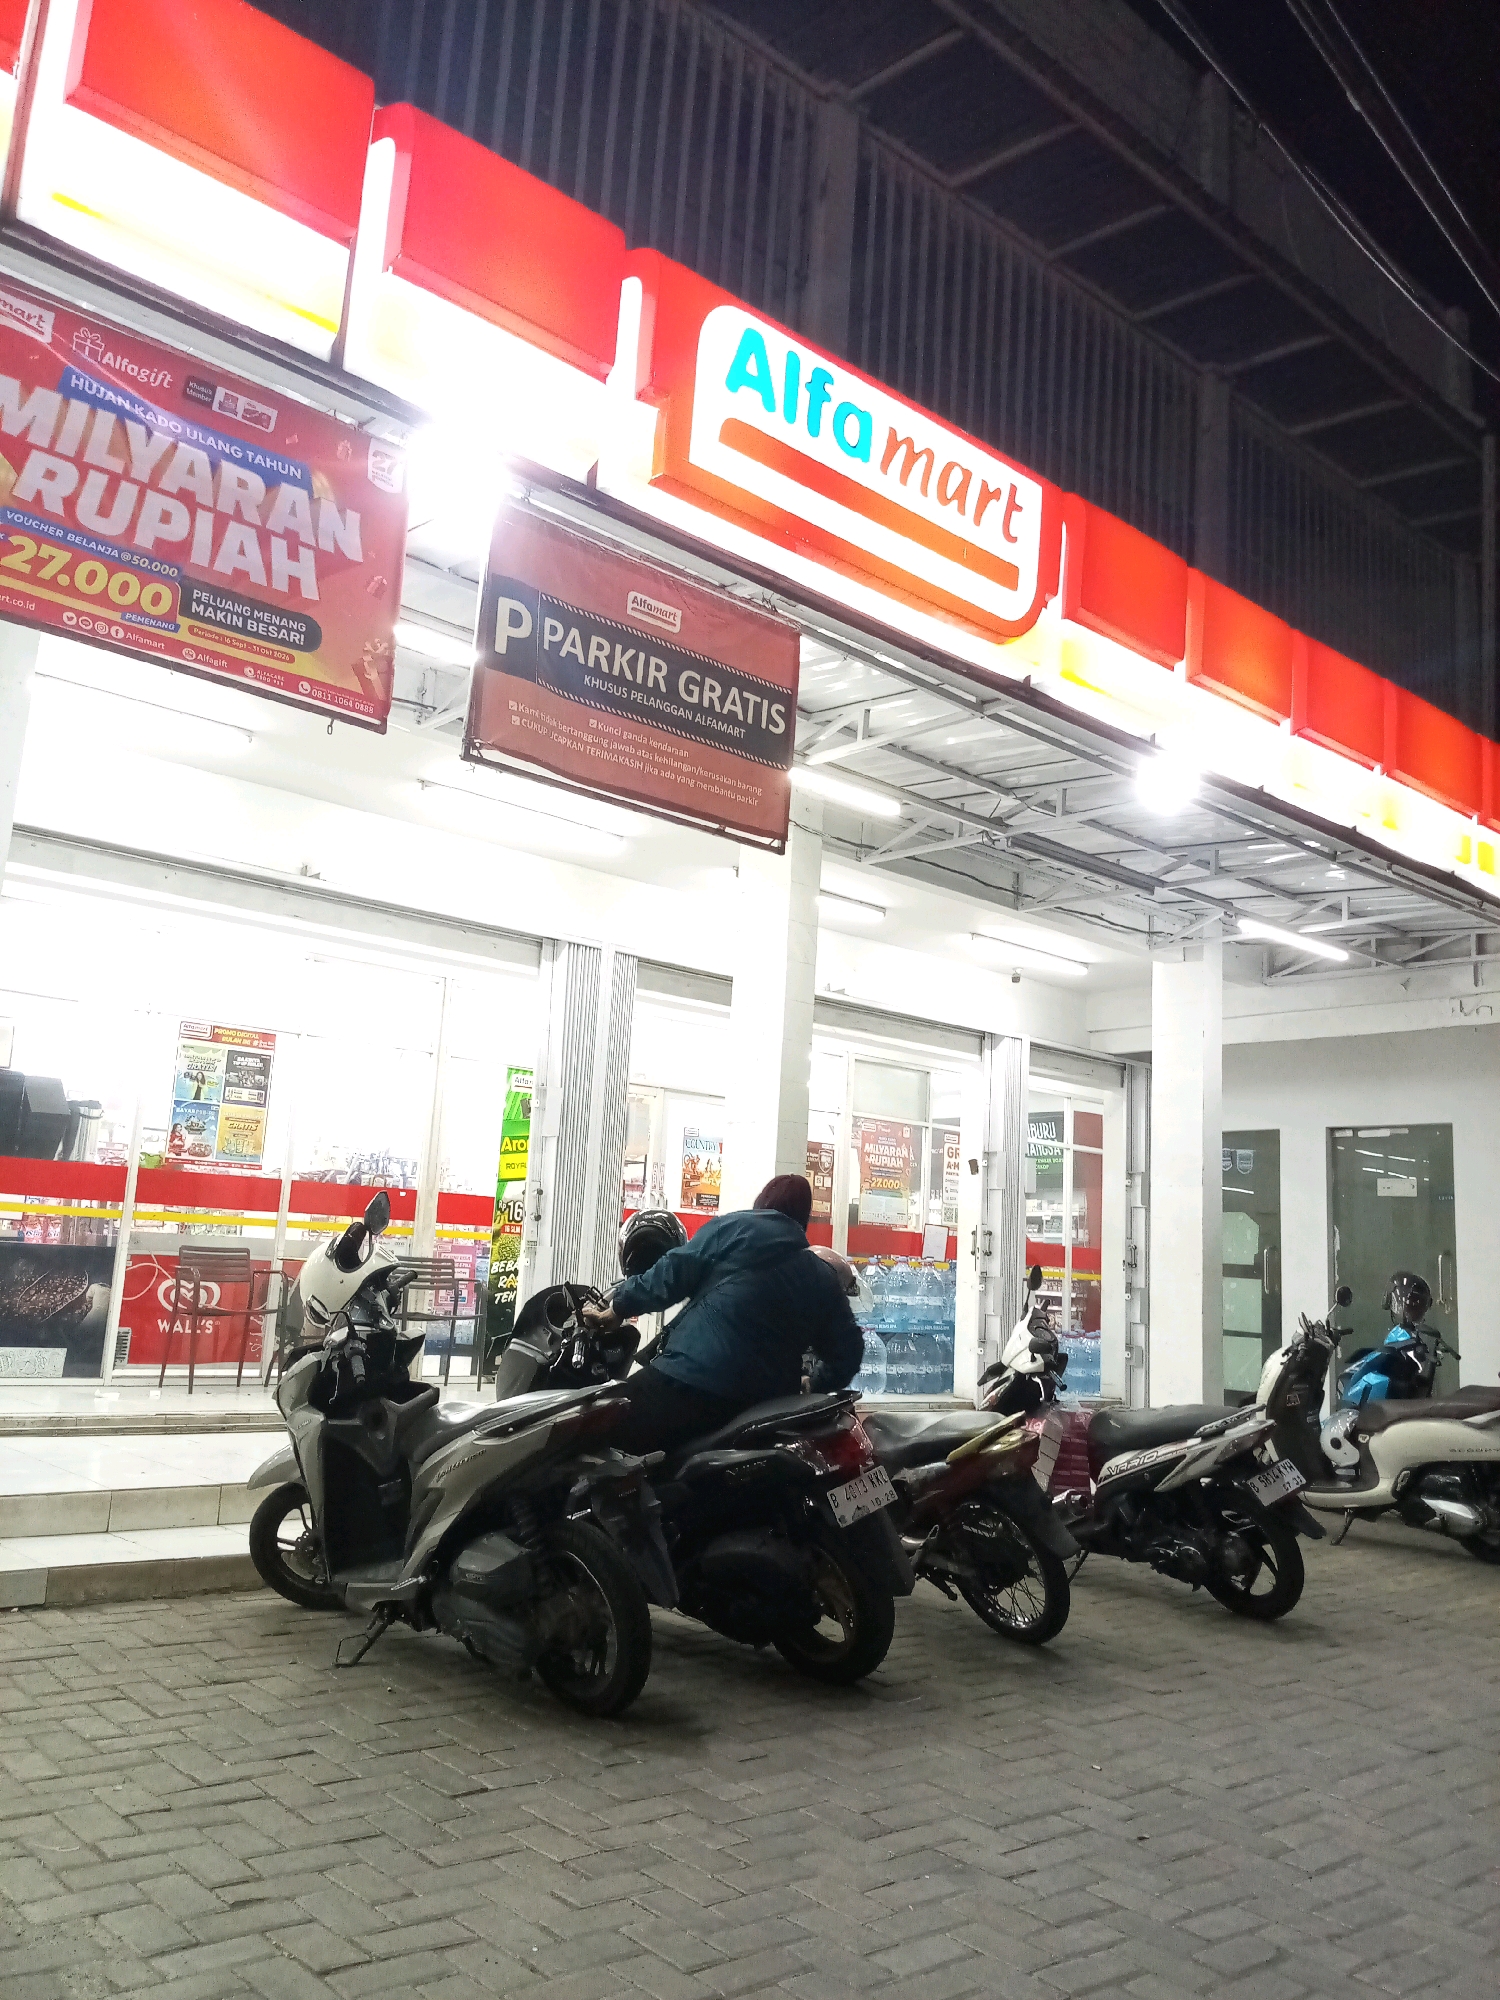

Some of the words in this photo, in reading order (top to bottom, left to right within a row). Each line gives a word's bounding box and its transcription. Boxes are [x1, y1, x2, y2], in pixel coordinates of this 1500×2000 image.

[101, 351, 173, 388] Alfagift
[70, 374, 131, 411] HUJAN
[132, 403, 183, 434] KADO
[185, 427, 243, 459] ULANG
[246, 451, 302, 480] TAHUN
[725, 328, 1024, 543] Alfamart
[0, 373, 364, 562] MILYARAN
[6, 510, 64, 538] VOUCHER
[66, 534, 119, 558] BELANJA
[120, 551, 179, 578] @50.000
[12, 450, 320, 601] RUPIAH
[0, 535, 173, 616] 27.000
[125, 612, 176, 631] PEMENANG
[191, 588, 252, 618] PELUANG
[253, 607, 307, 633] MENANG
[191, 603, 245, 632] MAKIN
[246, 619, 306, 647] BESAR!
[494, 596, 533, 655] P
[631, 595, 677, 621] Alfamart
[125, 632, 166, 650] Alfamart
[193, 627, 220, 640] Periode
[224, 636, 231, 644] 16
[232, 639, 247, 649] Sept
[260, 648, 273, 656] Okt
[197, 653, 229, 668] Alfagift
[311, 688, 331, 702] 0811
[334, 696, 353, 708] 1064
[543, 617, 668, 693] PARKIR
[678, 669, 787, 735] GRATIS
[583, 674, 628, 698] KHUSUS
[630, 689, 693, 721] PELANGGAN
[694, 714, 746, 739] ALFAMART
[518, 702, 539, 718] Kami
[540, 712, 558, 727] tidak
[558, 722, 609, 748] bertanggung
[609, 739, 635, 754] jawab
[636, 747, 653, 760] atas
[654, 753, 738, 787] kehilangan/kerusakan
[737, 779, 763, 797] barang
[597, 721, 622, 737] Kunci
[622, 731, 648, 746] ganda
[649, 737, 689, 758] kendaraan
[521, 718, 548, 736] CUKUP
[586, 745, 643, 771] TERIMAKASIH
[643, 762, 659, 776] jika
[660, 768, 676, 780] ada
[676, 774, 696, 788] yang
[696, 781, 736, 799] membantu
[736, 793, 759, 807] parkir
[685, 1138, 717, 1151] COUNTRY
[830, 1492, 839, 1508] B
